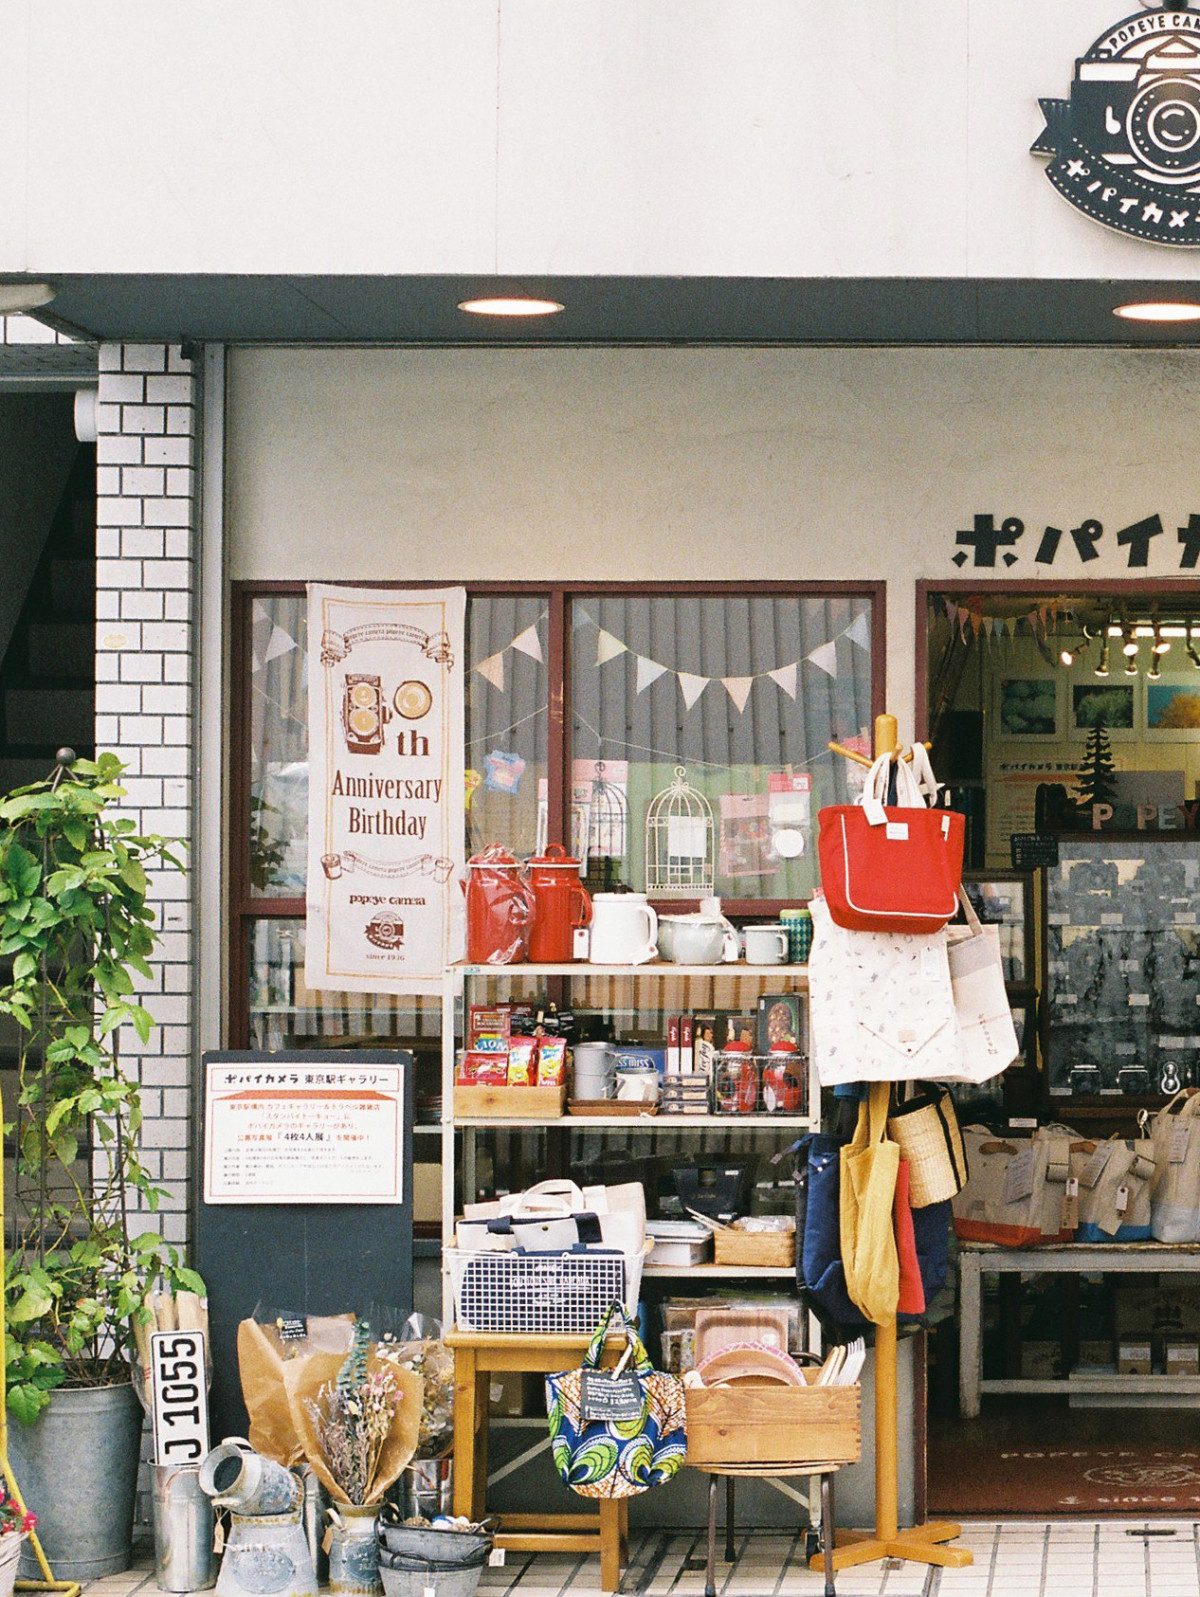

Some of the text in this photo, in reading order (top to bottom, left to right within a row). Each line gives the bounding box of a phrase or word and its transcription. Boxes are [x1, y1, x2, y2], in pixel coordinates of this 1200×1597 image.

[1109, 14, 1166, 49] POPEYE
[331, 769, 443, 804] Anniversary
[348, 807, 428, 840] Birthday
[224, 1073, 389, 1085] ポパイカメラ 東京駅ギャラリー
[158, 1337, 201, 1427] 1055
